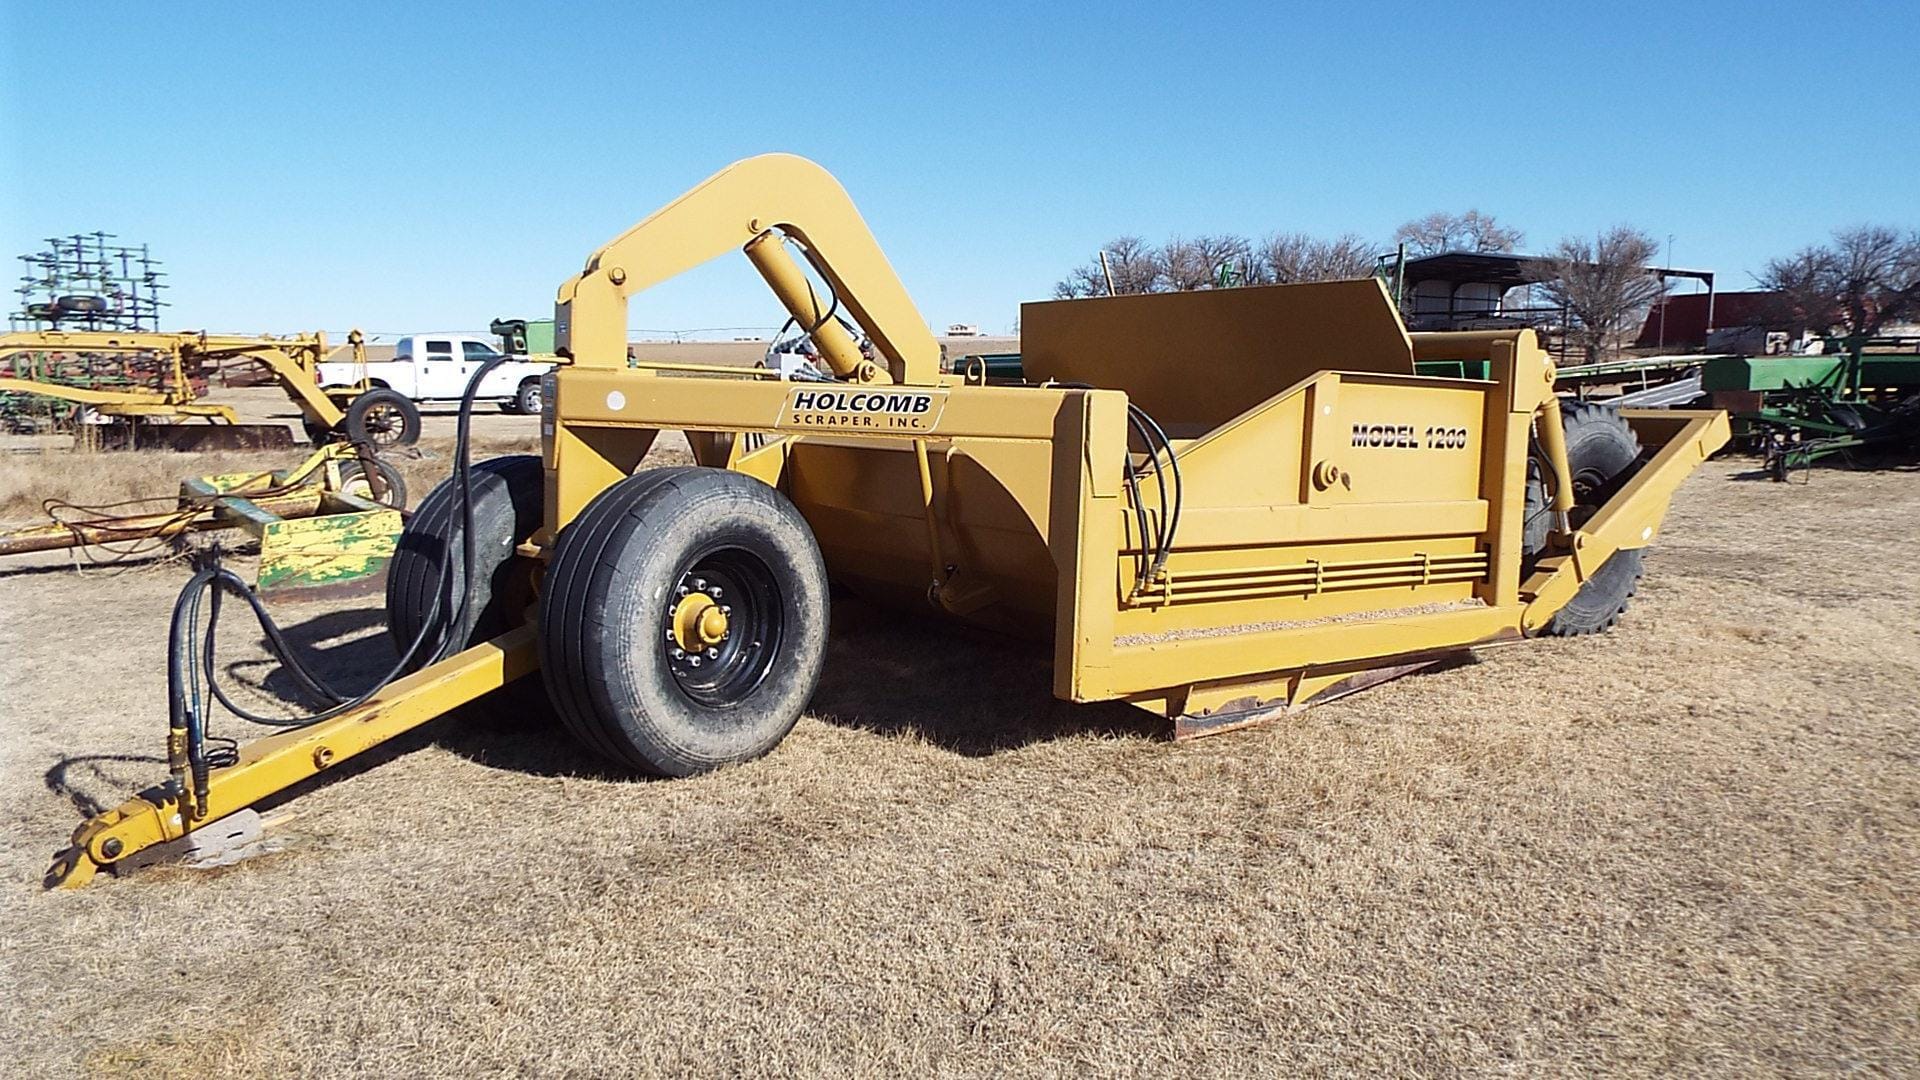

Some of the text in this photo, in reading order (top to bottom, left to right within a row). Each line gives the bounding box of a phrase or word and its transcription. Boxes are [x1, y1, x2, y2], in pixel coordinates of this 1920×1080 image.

[794, 392, 930, 412] HOLCOMB
[793, 414, 926, 428] SCRAPER, INC.
[1351, 425, 1467, 449] MODEL 1200
